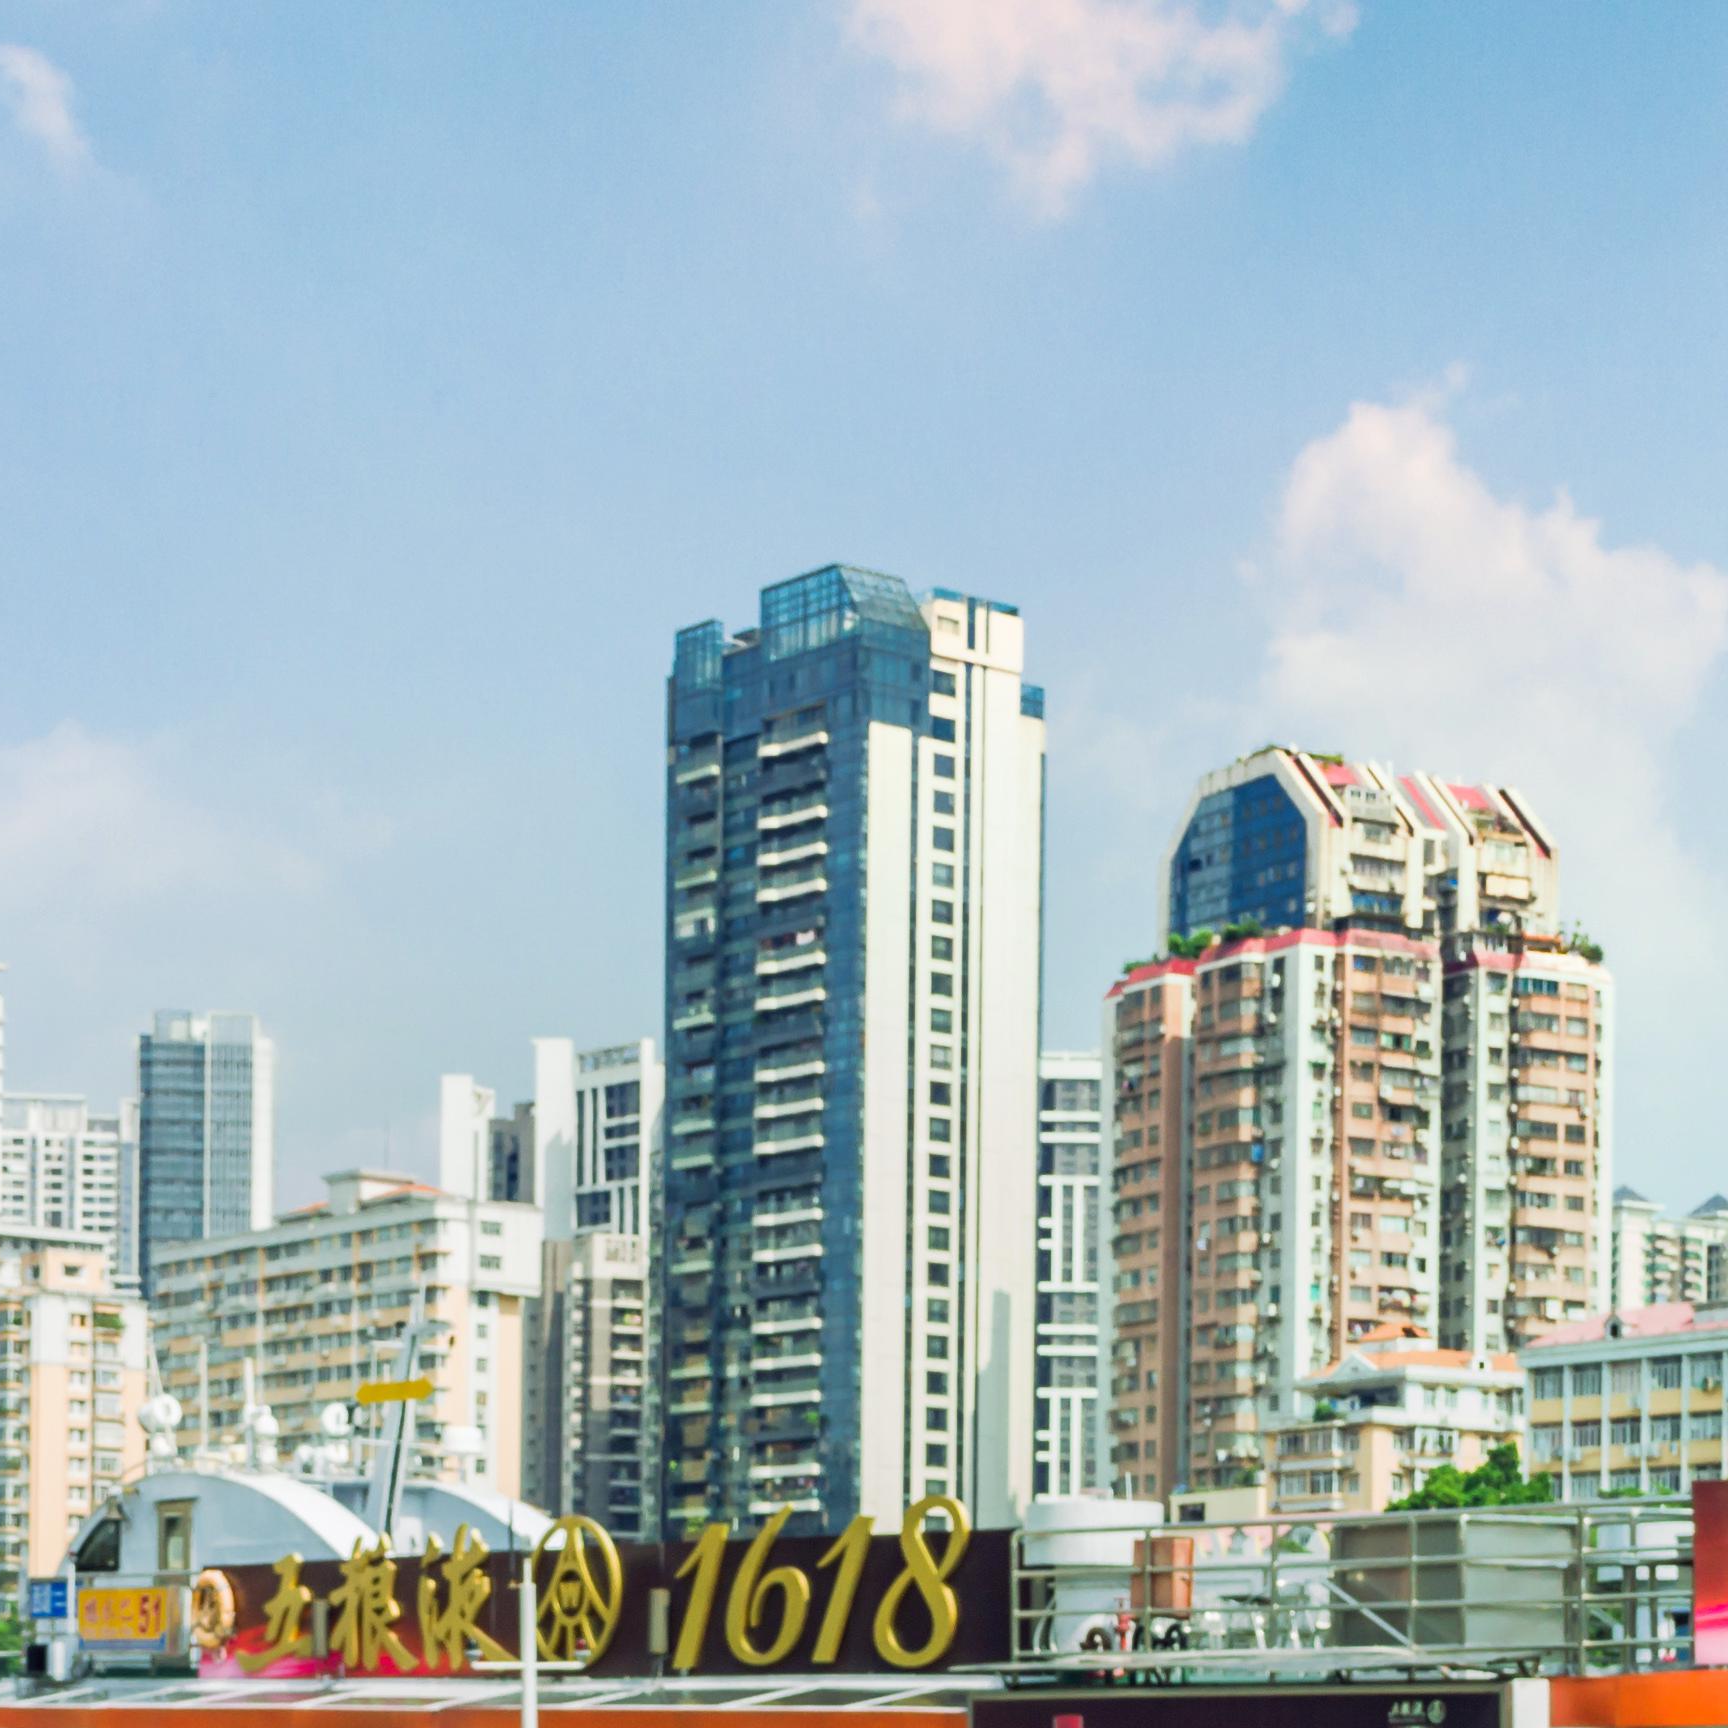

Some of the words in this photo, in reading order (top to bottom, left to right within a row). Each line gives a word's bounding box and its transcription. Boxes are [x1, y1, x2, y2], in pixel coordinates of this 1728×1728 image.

[237, 1523, 519, 1672] 五粮液
[672, 1494, 971, 1669] 1618
